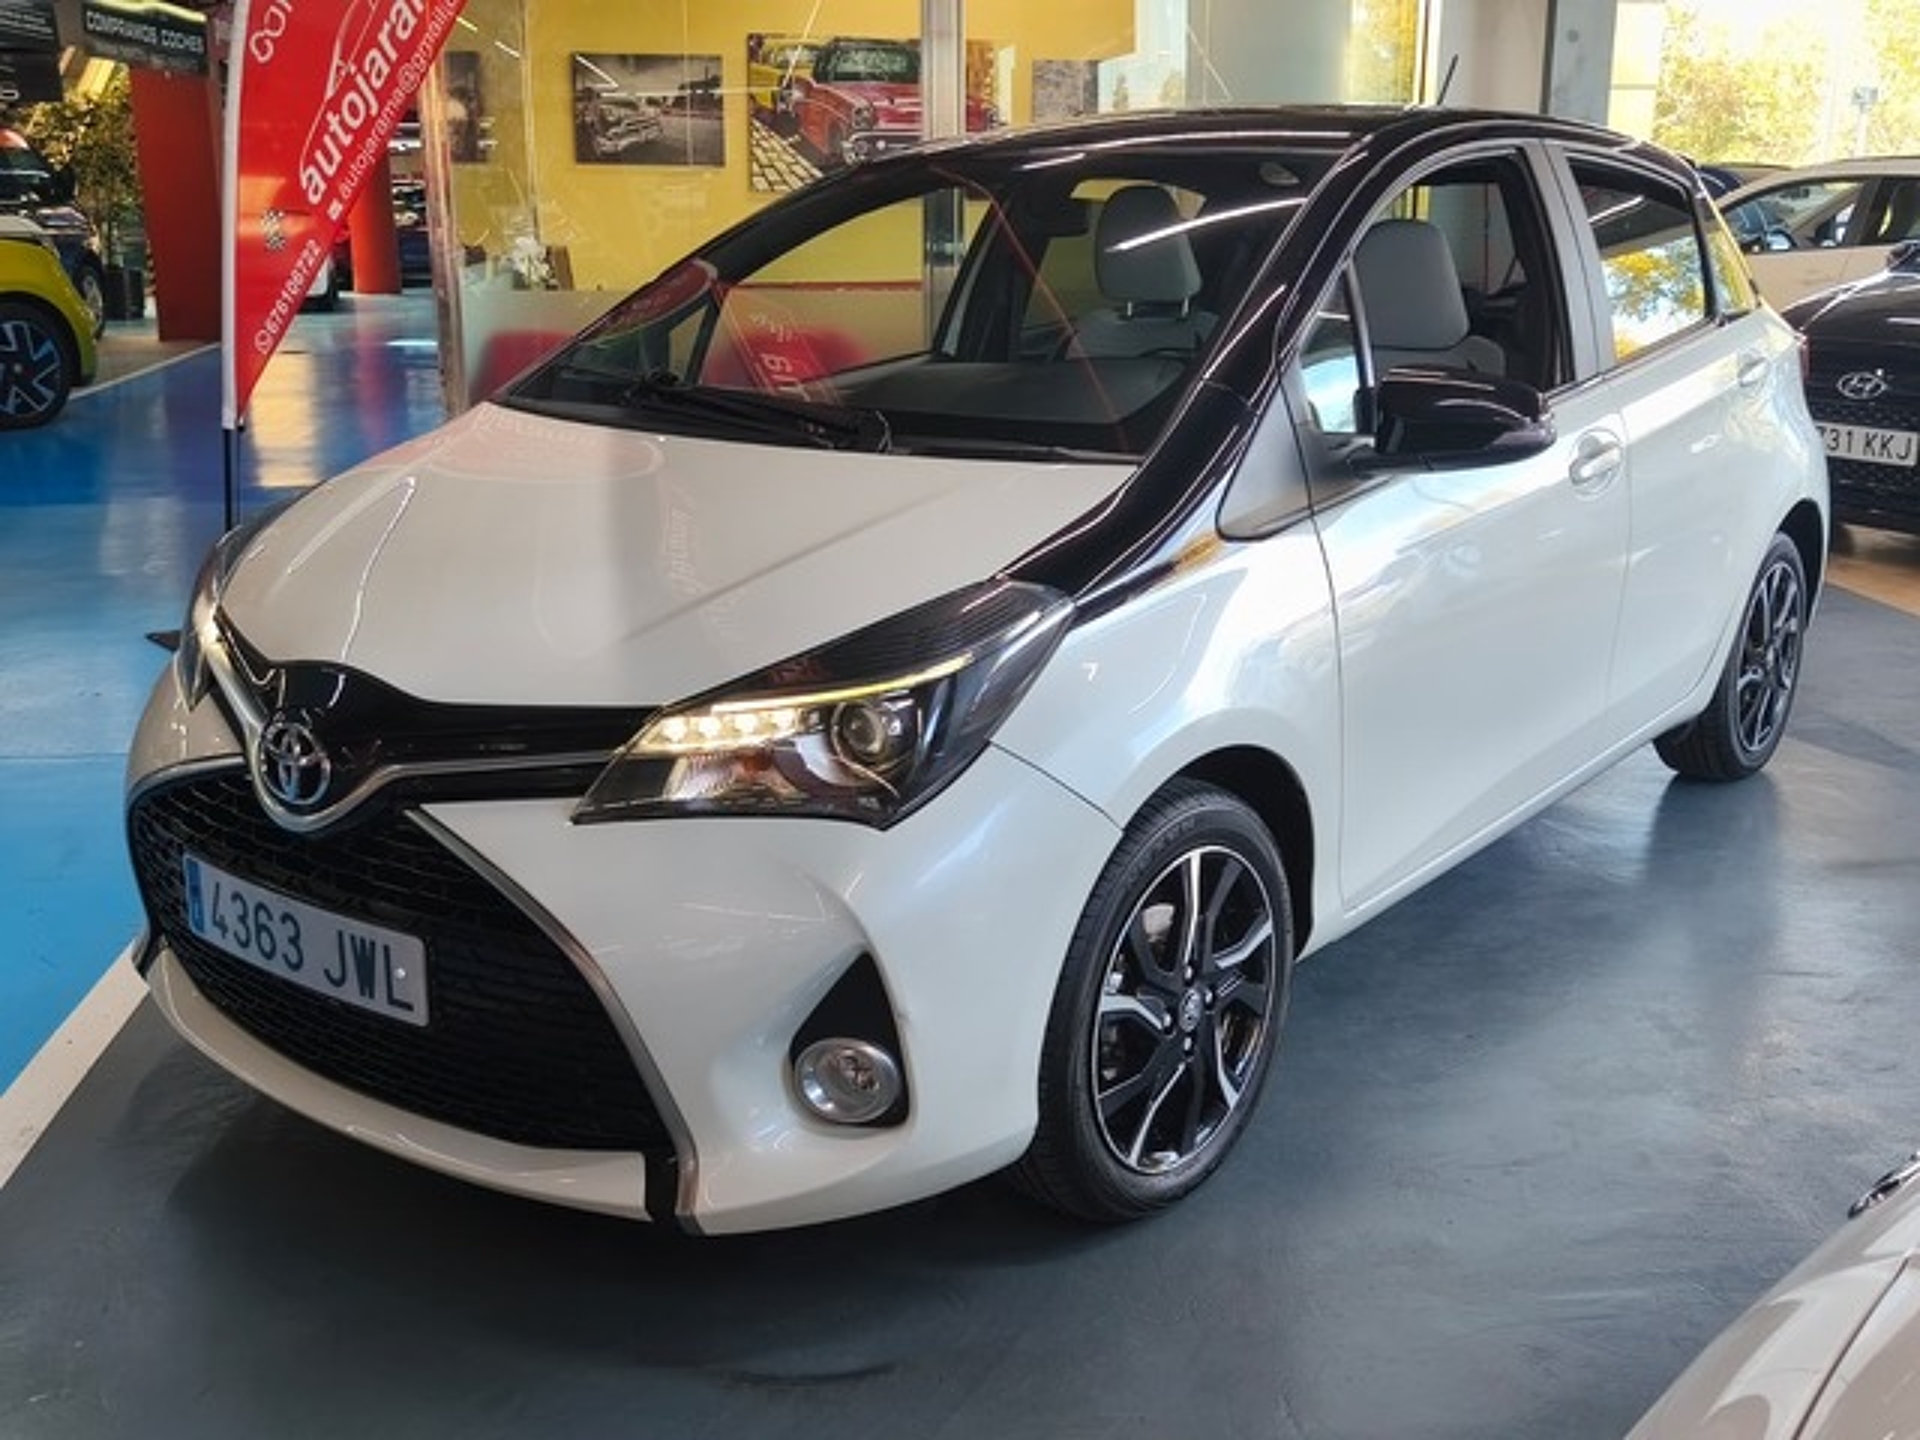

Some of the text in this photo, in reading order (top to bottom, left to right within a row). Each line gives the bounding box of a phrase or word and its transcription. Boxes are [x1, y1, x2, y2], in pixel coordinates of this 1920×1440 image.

[1863, 431, 1912, 460] KKJ
[211, 881, 414, 1011] 4363 JWL
